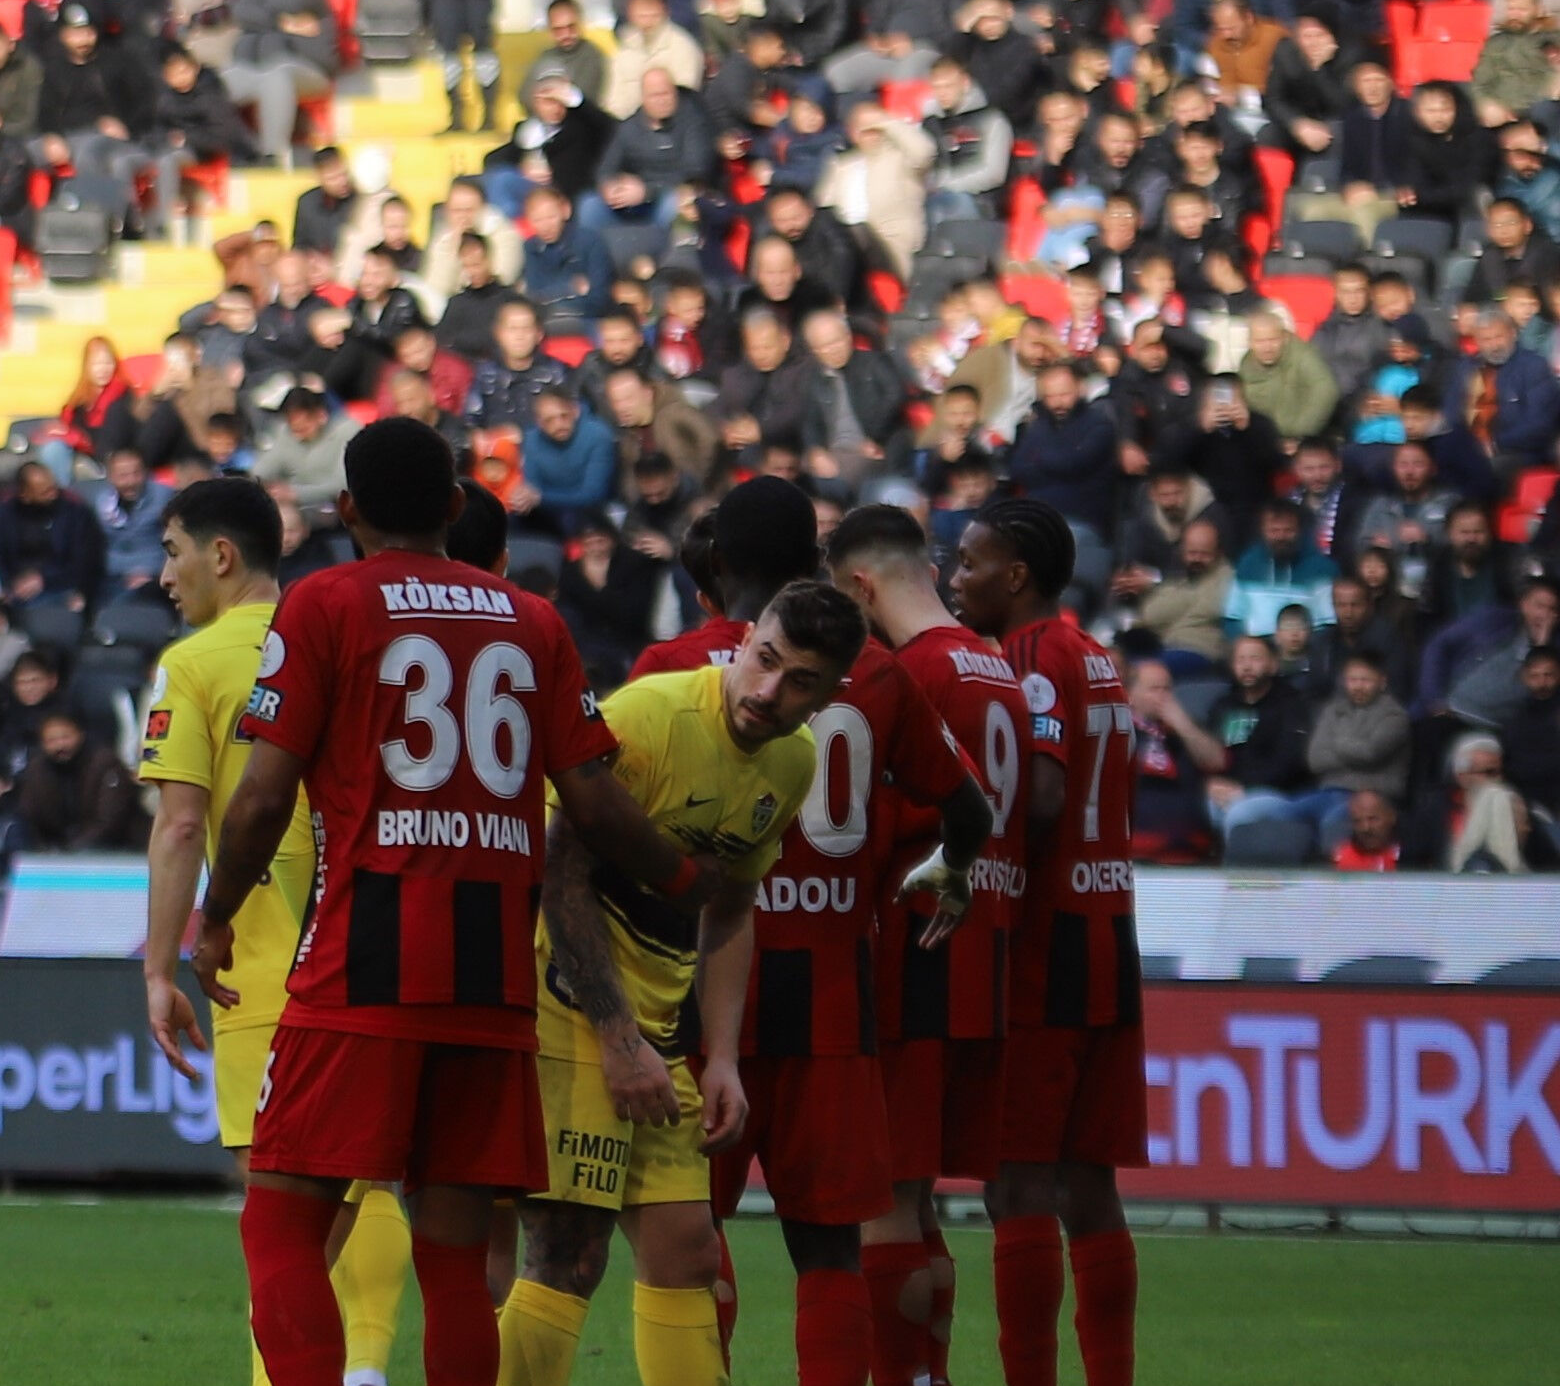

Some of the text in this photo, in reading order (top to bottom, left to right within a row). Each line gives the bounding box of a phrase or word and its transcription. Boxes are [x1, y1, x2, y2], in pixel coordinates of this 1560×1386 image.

[379, 576, 516, 616] KÖKSAN
[378, 633, 537, 800] 36
[377, 809, 471, 849] BRUNO
[754, 876, 856, 913] ADOU
[1071, 859, 1133, 894] OKER
[1146, 1013, 1560, 1176] cnTURK
